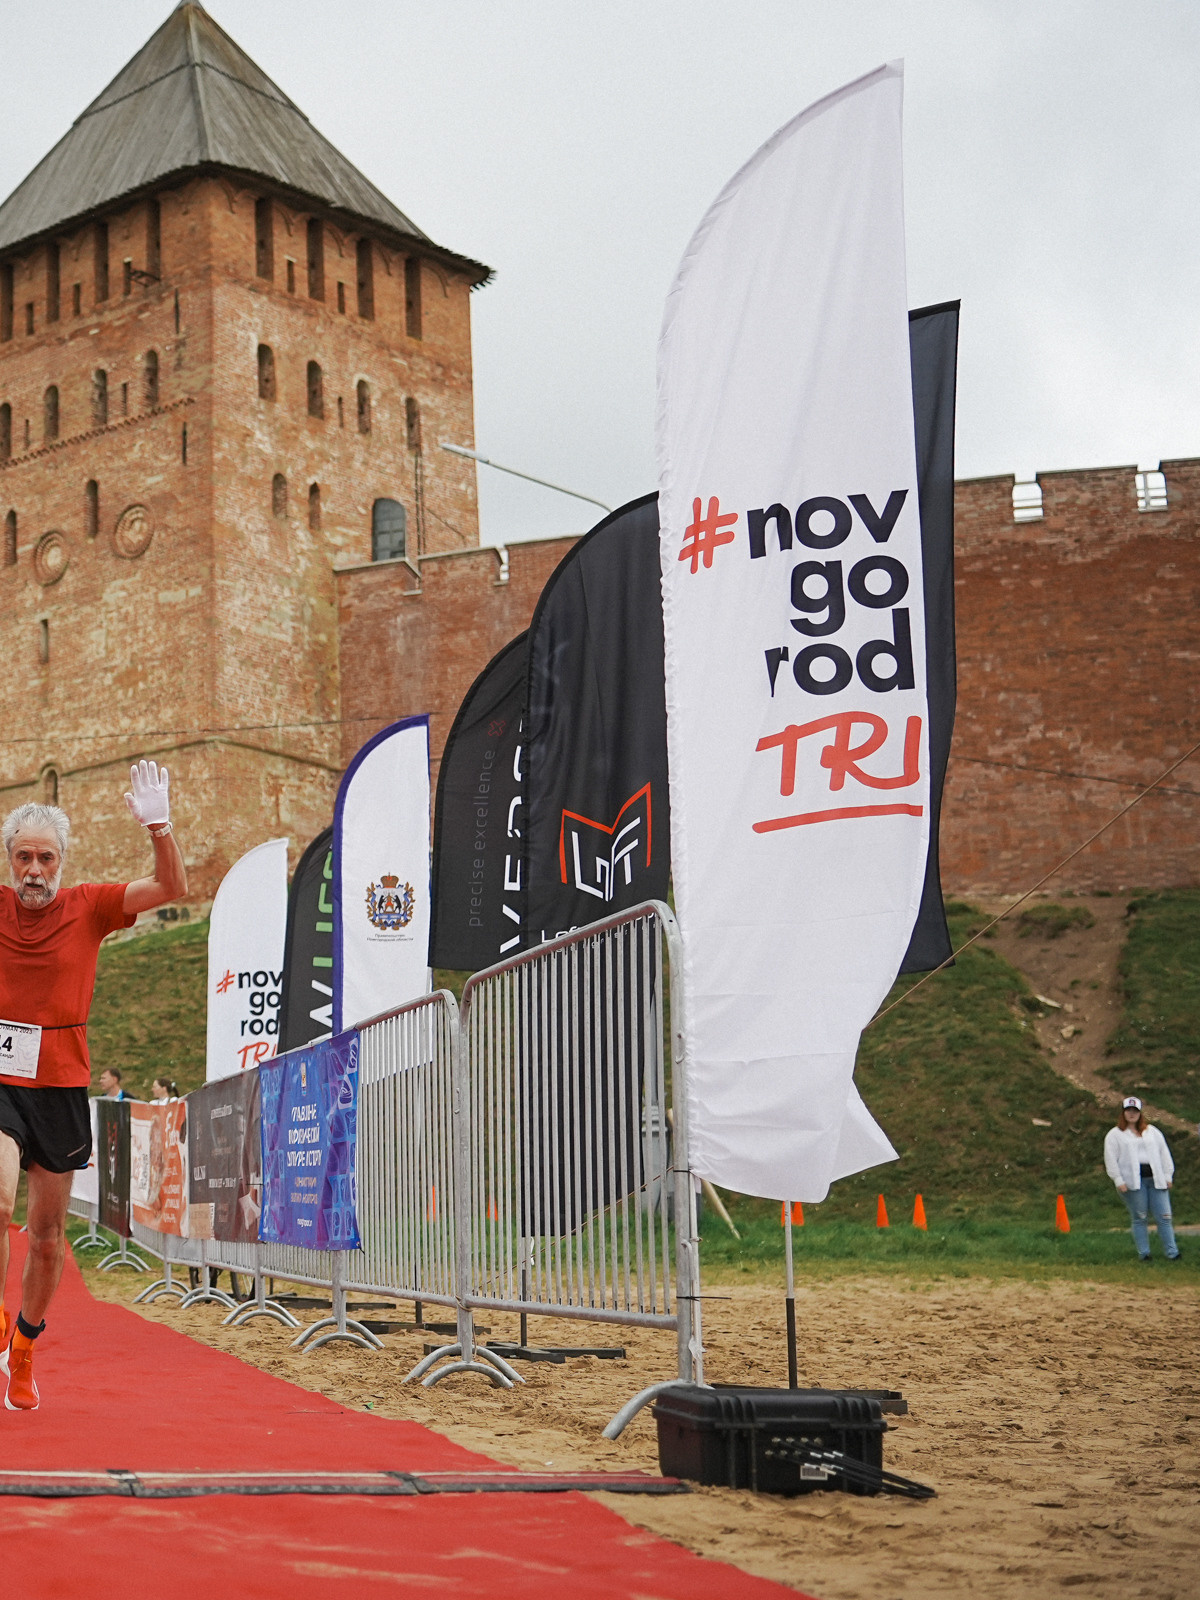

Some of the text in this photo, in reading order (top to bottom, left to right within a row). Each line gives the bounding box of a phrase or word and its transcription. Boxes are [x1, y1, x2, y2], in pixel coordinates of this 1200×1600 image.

[678, 489, 909, 574] #nov
[789, 554, 910, 637] go
[764, 608, 916, 698] rod
[754, 710, 923, 797] TRI
[469, 750, 496, 928] precise excellence
[240, 1008, 280, 1036] rod
[249, 990, 281, 1017] go
